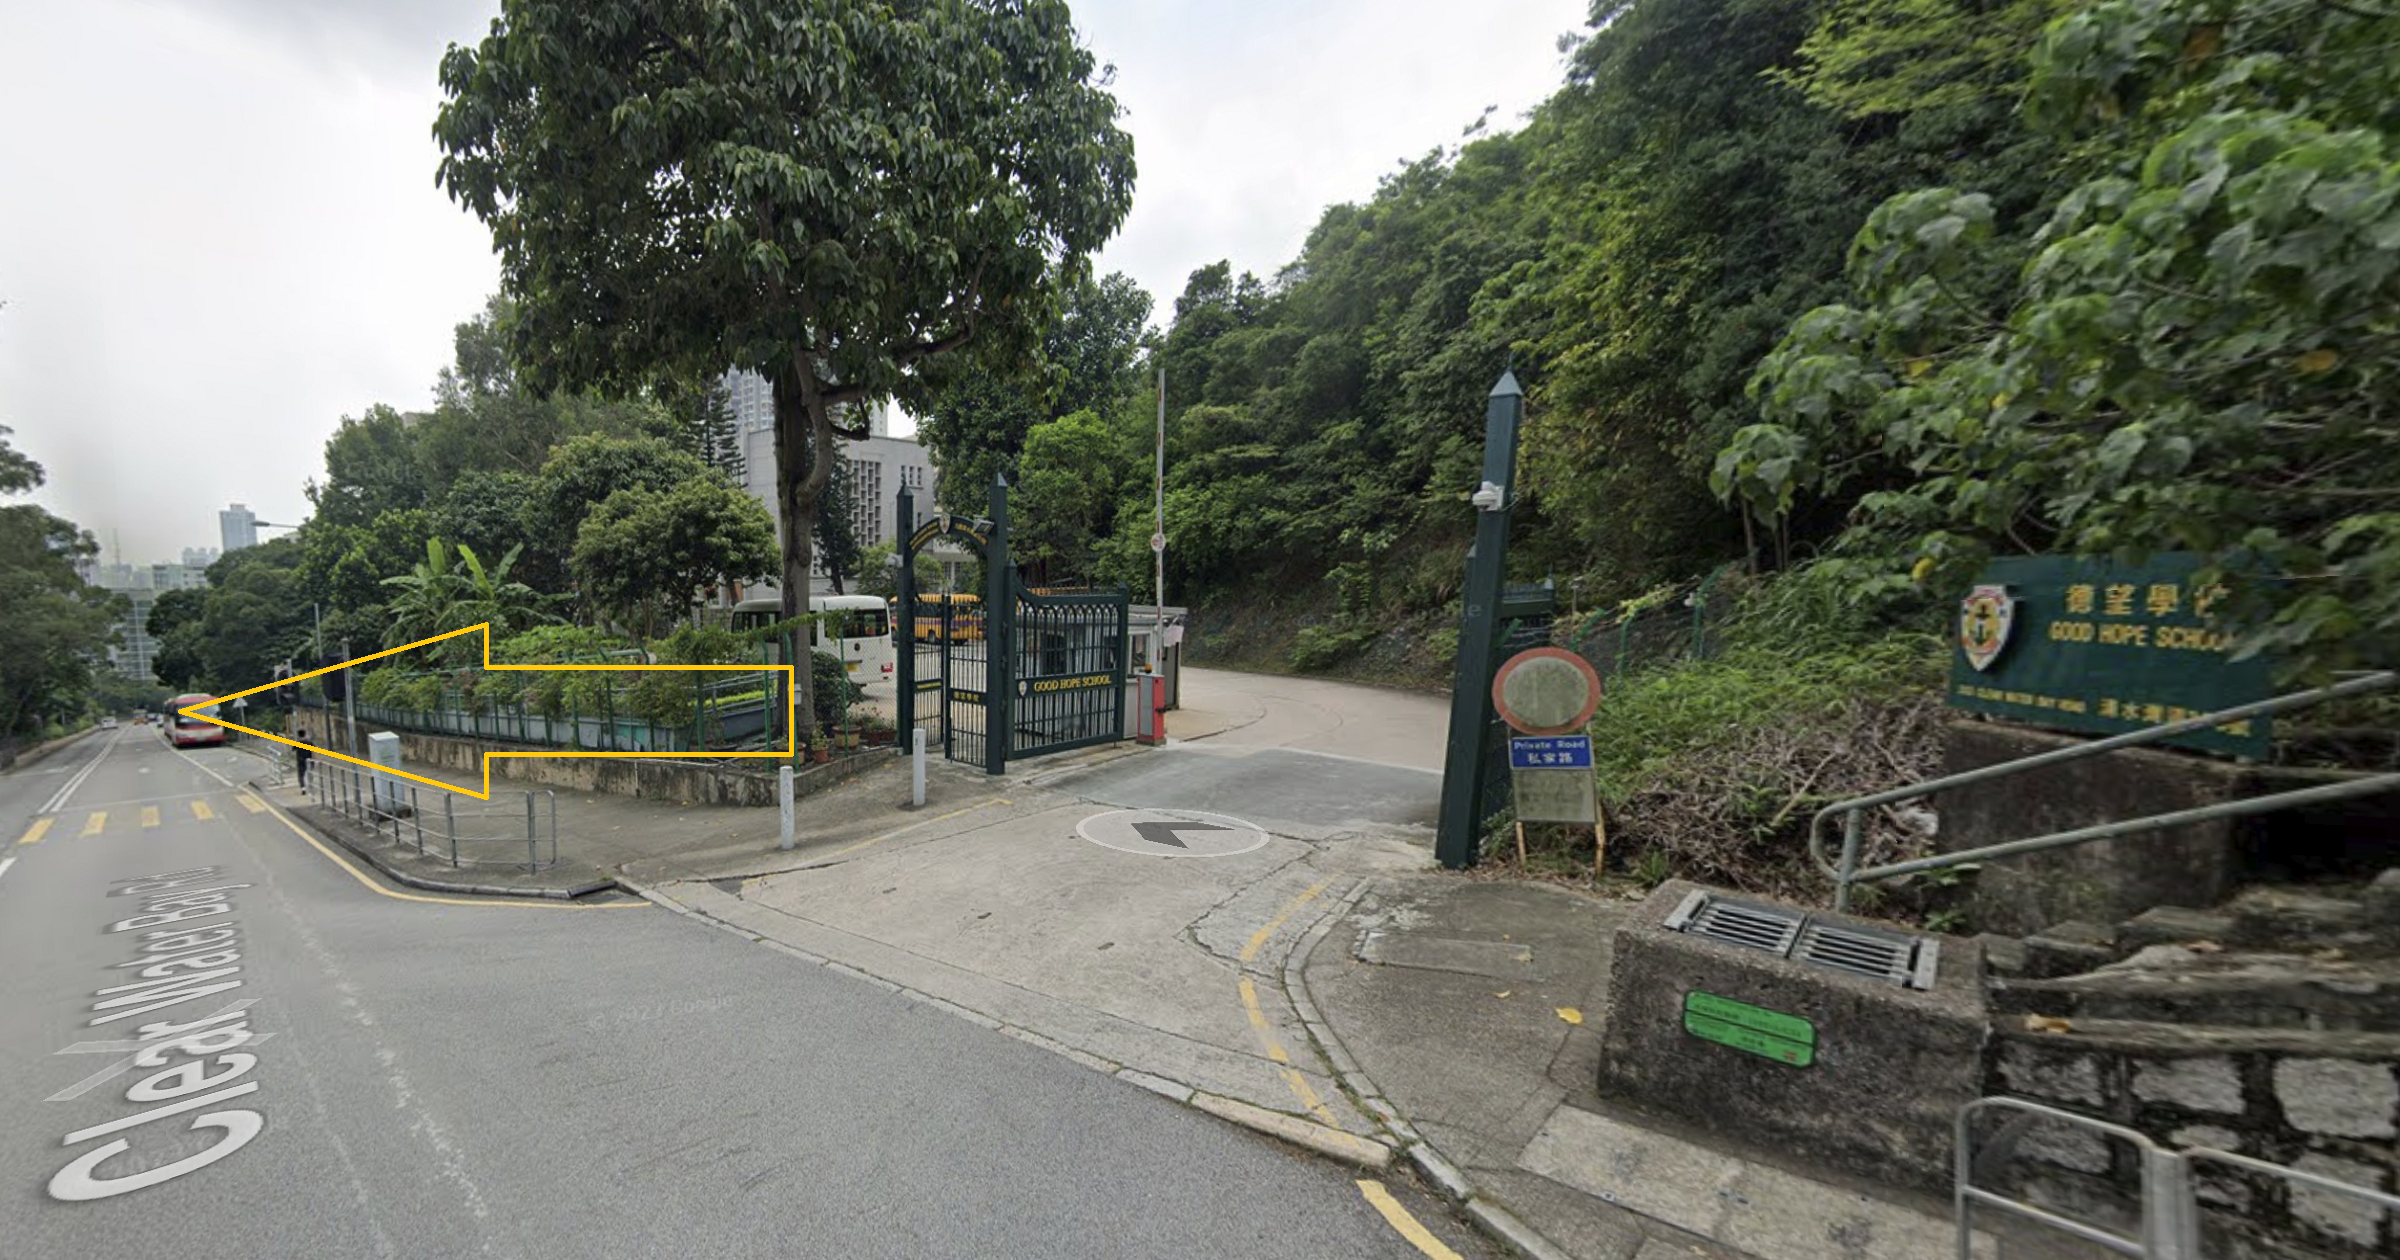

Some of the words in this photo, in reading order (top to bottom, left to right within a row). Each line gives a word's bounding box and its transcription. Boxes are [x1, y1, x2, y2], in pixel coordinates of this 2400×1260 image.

[2049, 621, 2094, 642] GOOD
[2098, 623, 2149, 646] HOPE
[1034, 680, 1059, 692] GOOD
[1060, 678, 1080, 689] HOPE
[1082, 675, 1112, 687] SCHOOL
[1513, 741, 1551, 750] Private
[1556, 740, 1586, 749] Road
